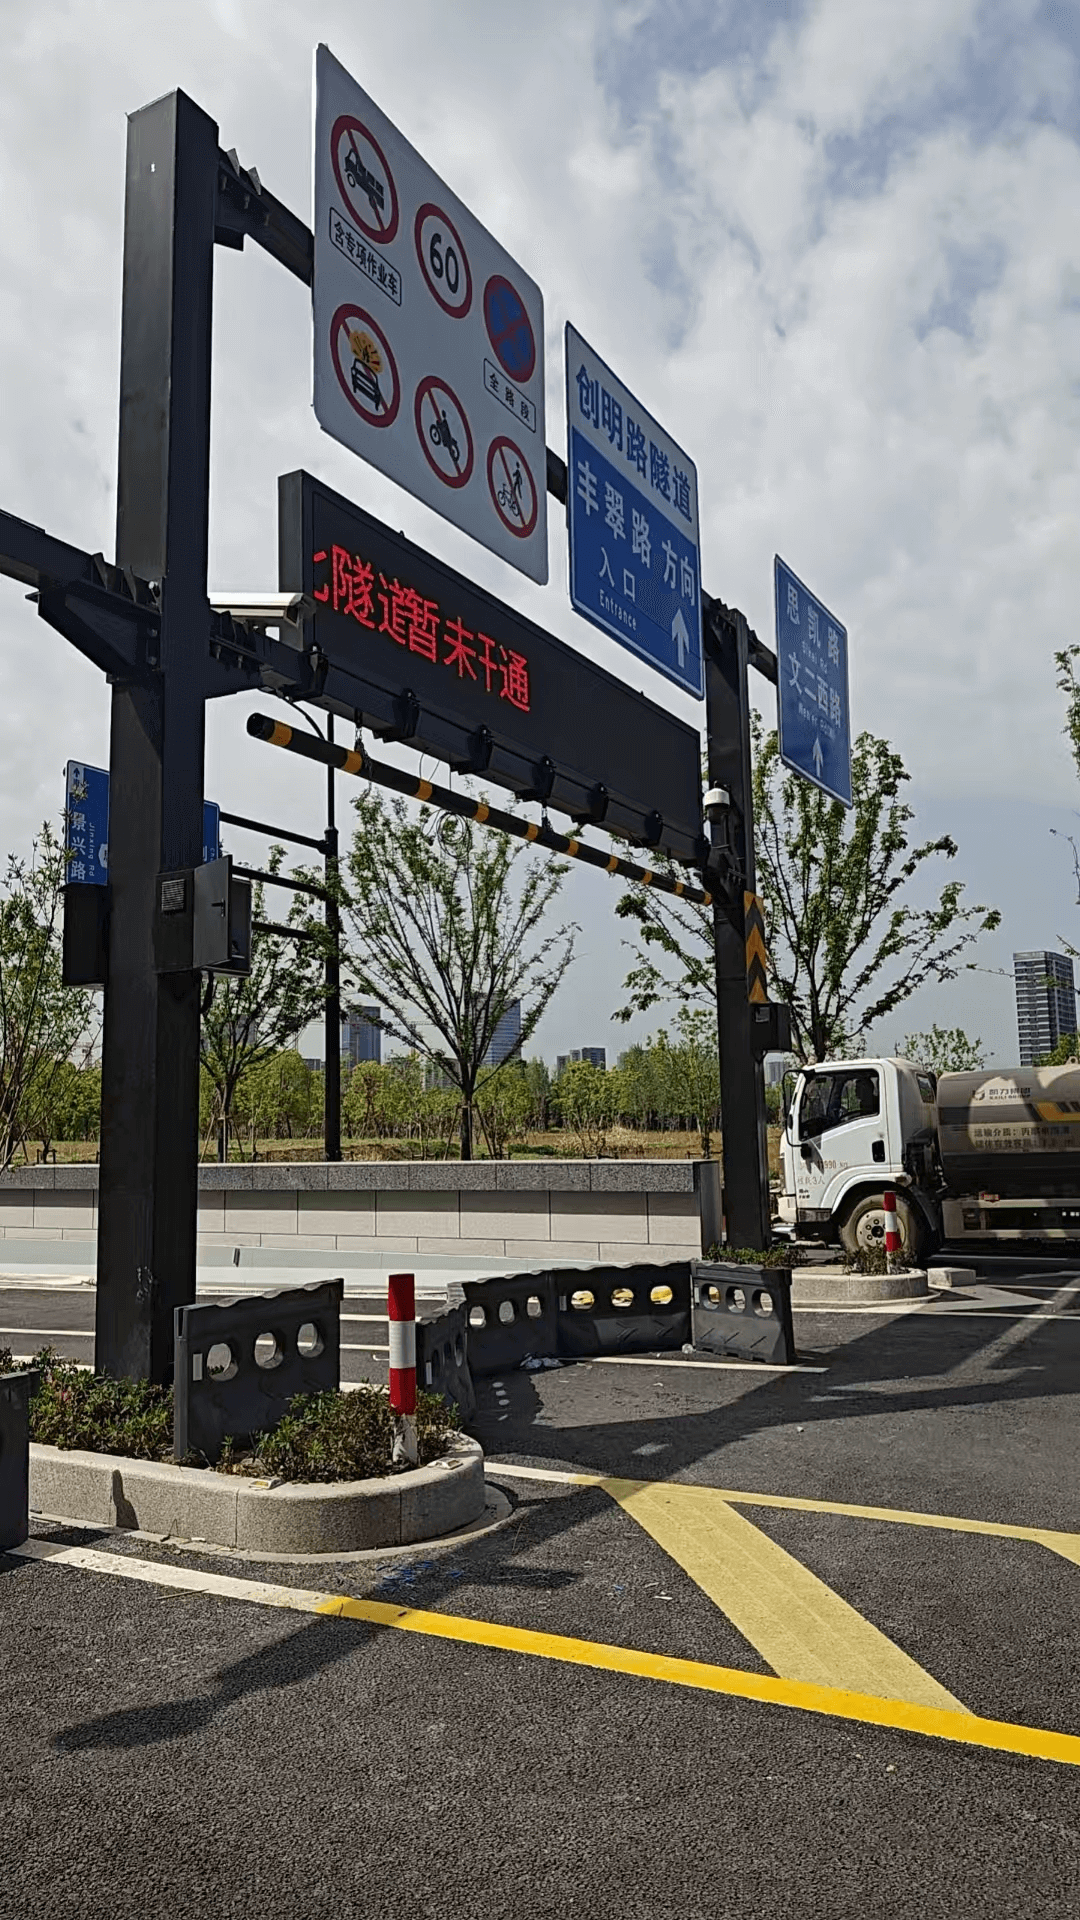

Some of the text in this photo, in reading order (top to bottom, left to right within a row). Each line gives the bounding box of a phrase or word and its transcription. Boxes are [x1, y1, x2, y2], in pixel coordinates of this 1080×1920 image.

[333, 221, 399, 298] 含专项作业车
[430, 232, 459, 294] 60
[490, 372, 531, 424] 全路段
[576, 364, 692, 524] 创明路隧道
[599, 547, 636, 602] 入口
[600, 589, 637, 632] Entrance
[788, 652, 841, 729] 文二西路
[72, 812, 86, 881] 景兴路
[89, 865, 95, 877] Rd
